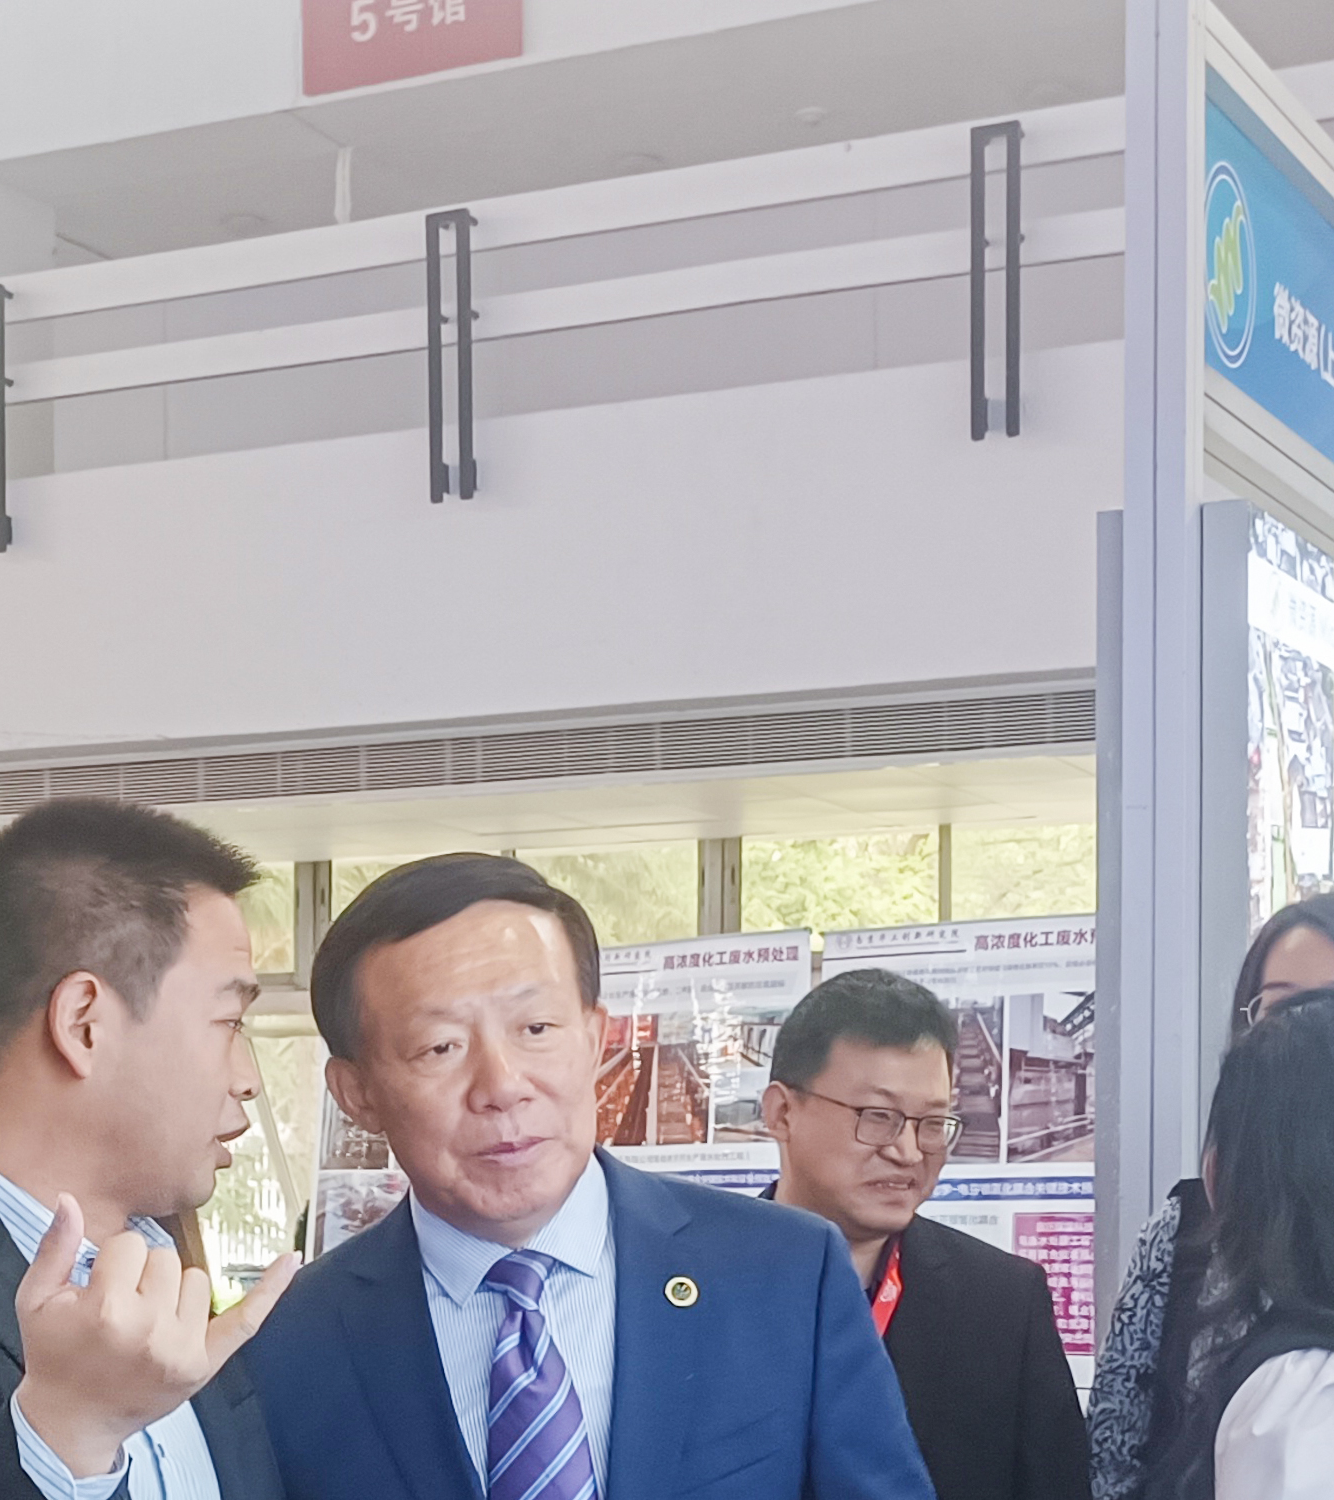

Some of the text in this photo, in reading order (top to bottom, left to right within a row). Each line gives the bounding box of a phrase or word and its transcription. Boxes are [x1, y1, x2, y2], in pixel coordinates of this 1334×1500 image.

[662, 946, 800, 971] 高浓度化工废水预处理
